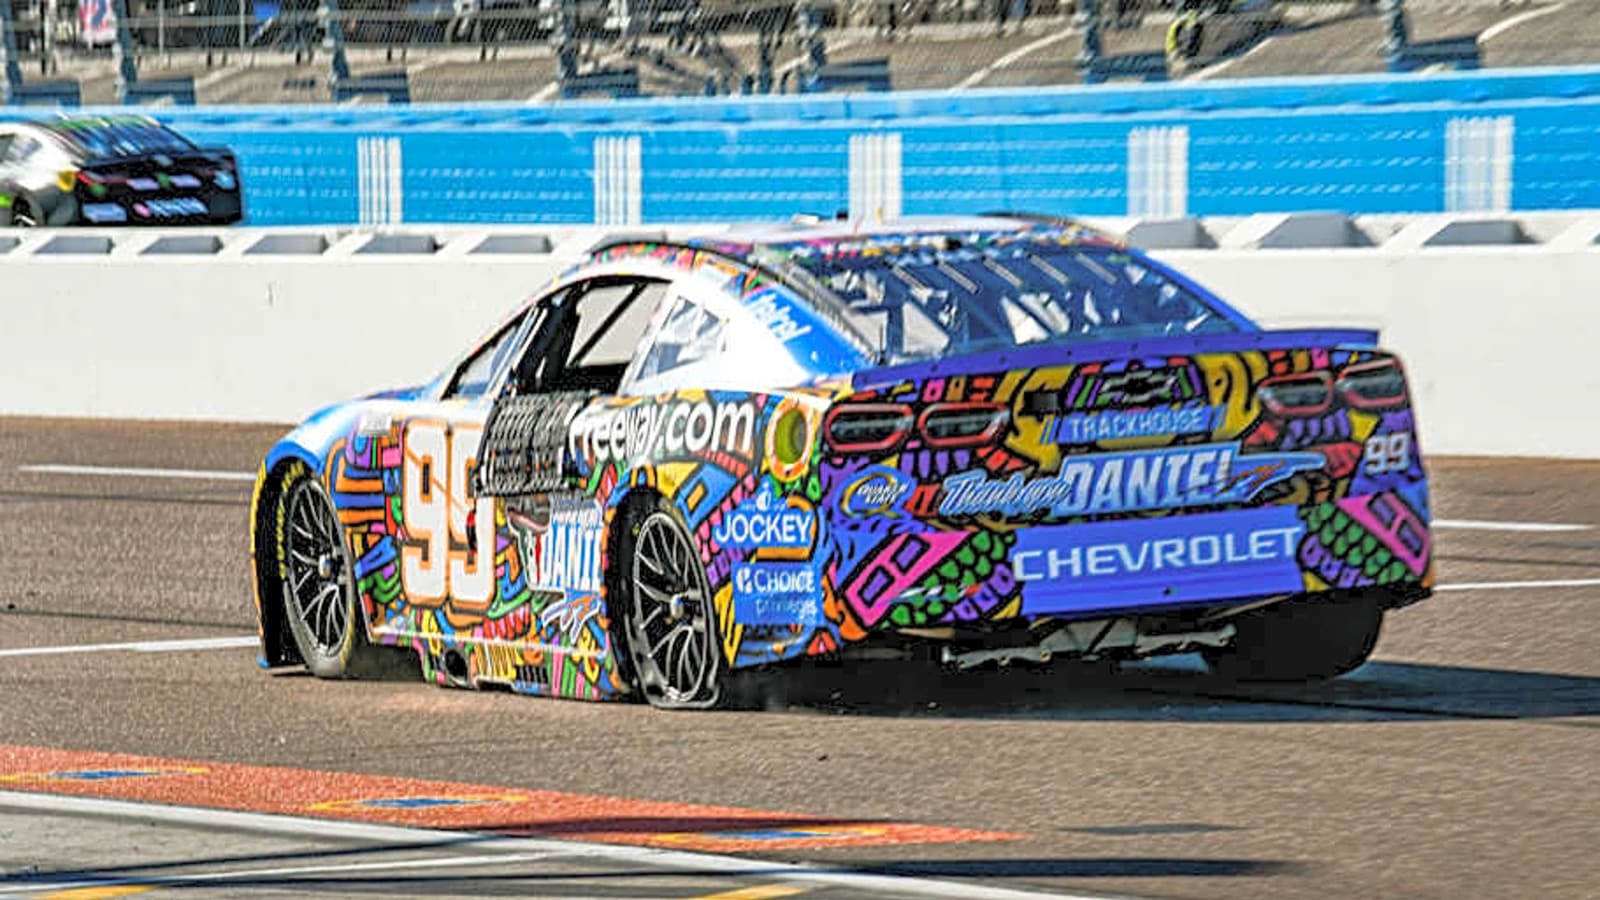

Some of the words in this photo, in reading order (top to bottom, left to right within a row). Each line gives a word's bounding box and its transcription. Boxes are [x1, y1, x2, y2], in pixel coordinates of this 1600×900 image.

[1069, 404, 1206, 438] TRACKHOUSE
[1364, 432, 1412, 475] 99
[1057, 447, 1234, 512] DANIEL
[402, 416, 497, 608] 99
[715, 513, 812, 543] JOCKEY
[1013, 525, 1301, 582] CHEVROLET
